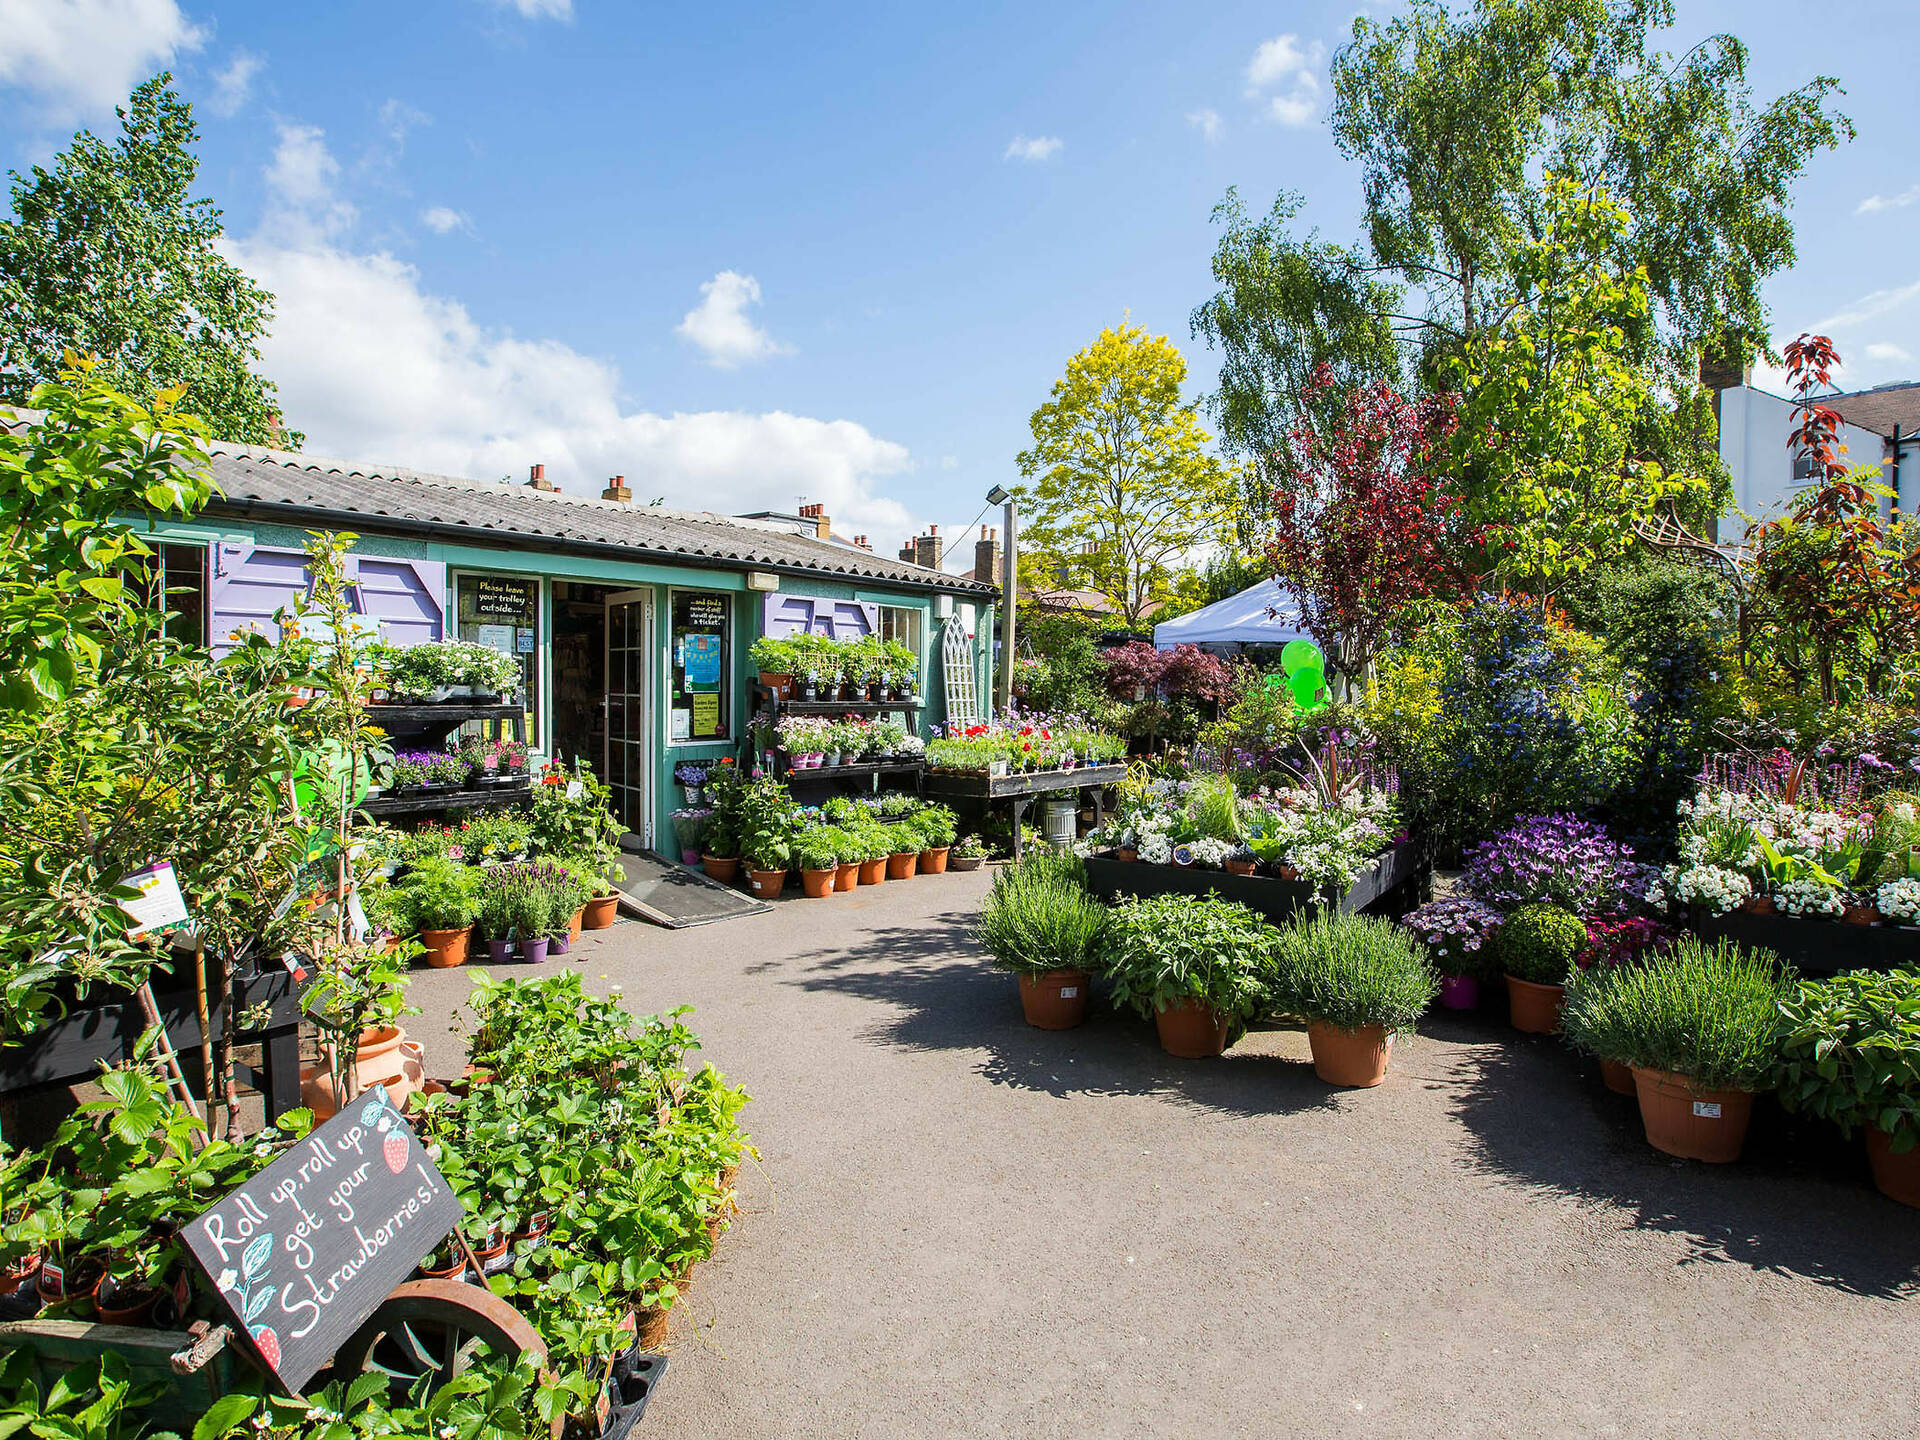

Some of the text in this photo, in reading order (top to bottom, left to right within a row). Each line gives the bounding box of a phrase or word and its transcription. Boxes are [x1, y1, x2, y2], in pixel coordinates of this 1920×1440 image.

[480, 581, 524, 594] Please leave
[479, 594, 525, 606] your trolley
[481, 604, 522, 613] outside...
[699, 618, 721, 626] ticket.
[203, 1192, 269, 1263] Roll
[297, 1137, 337, 1183] roll
[285, 1161, 371, 1270] get your
[280, 1163, 440, 1338] Strawberries!
